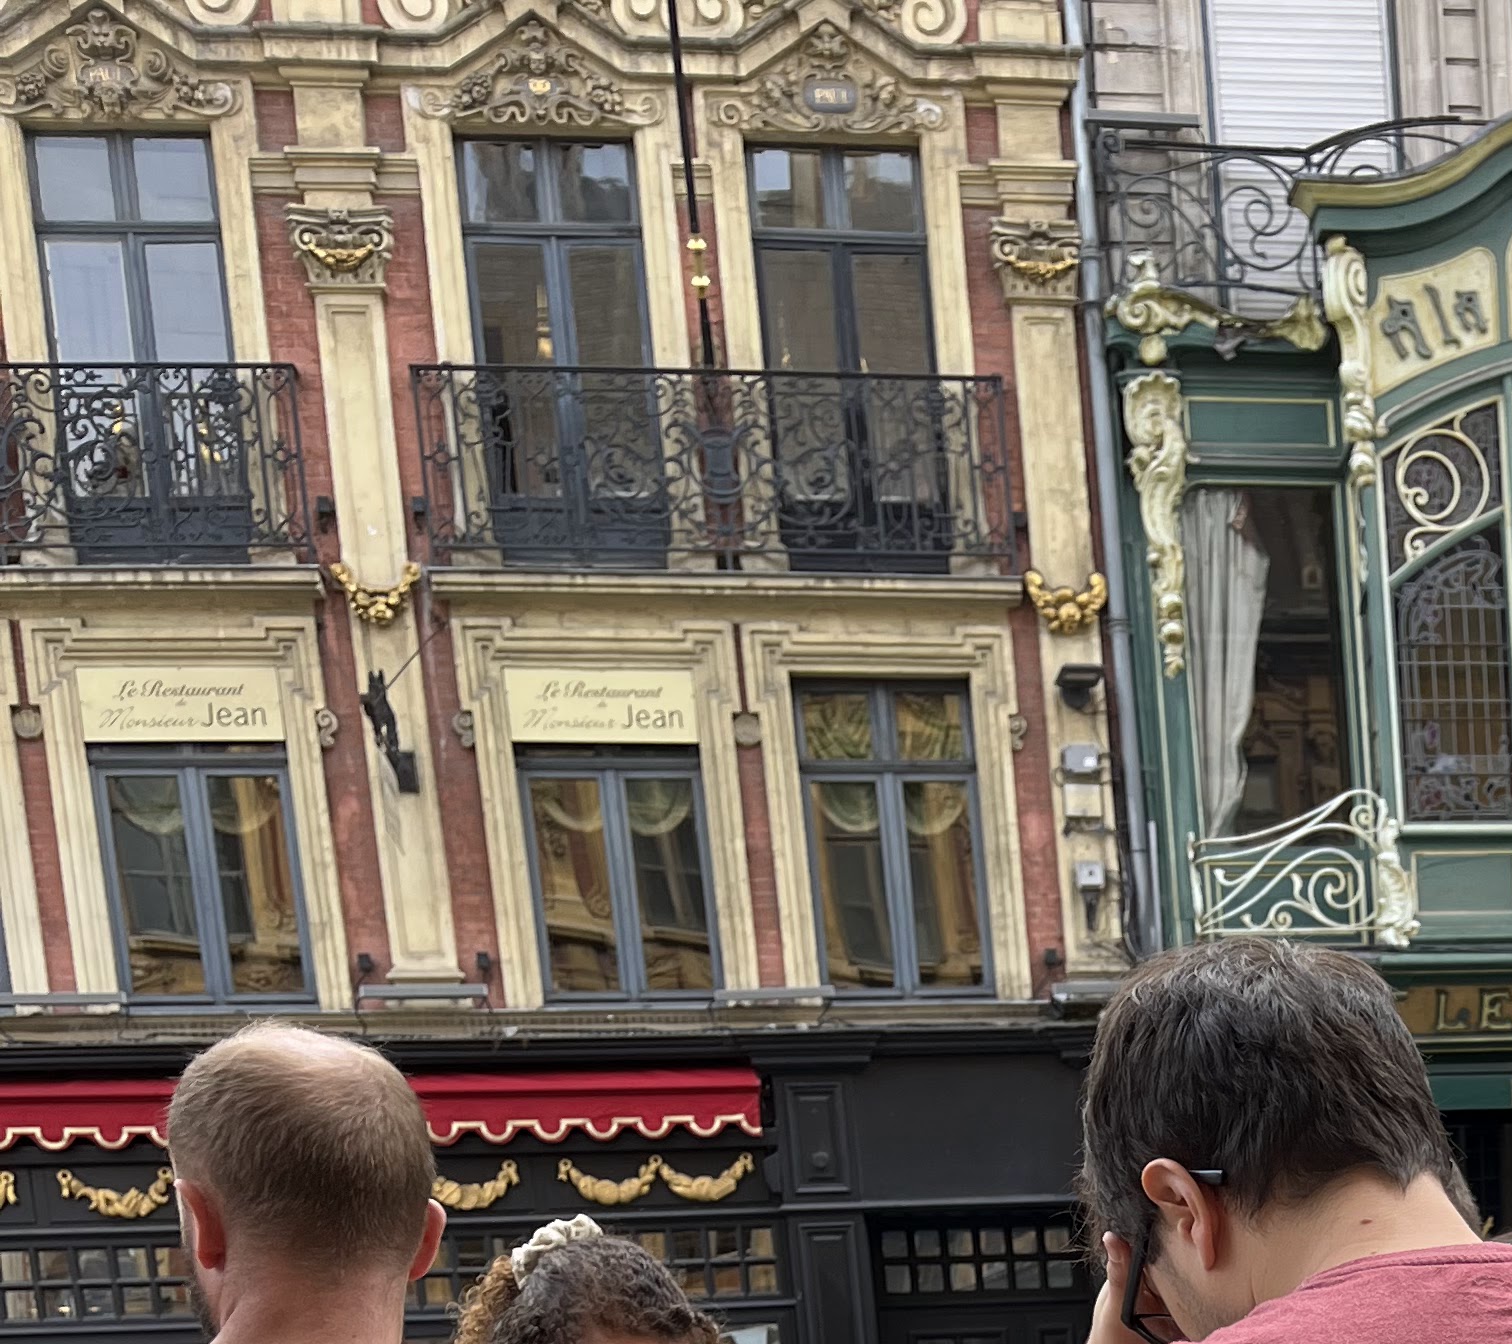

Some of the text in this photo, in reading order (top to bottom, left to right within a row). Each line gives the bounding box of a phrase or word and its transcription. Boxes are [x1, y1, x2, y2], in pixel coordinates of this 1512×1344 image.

[112, 680, 244, 700] Le Restaurant
[536, 680, 663, 701] Le Restaurant
[98, 702, 267, 731] Monsieur Jean
[523, 704, 684, 731] Monsieur Jean
